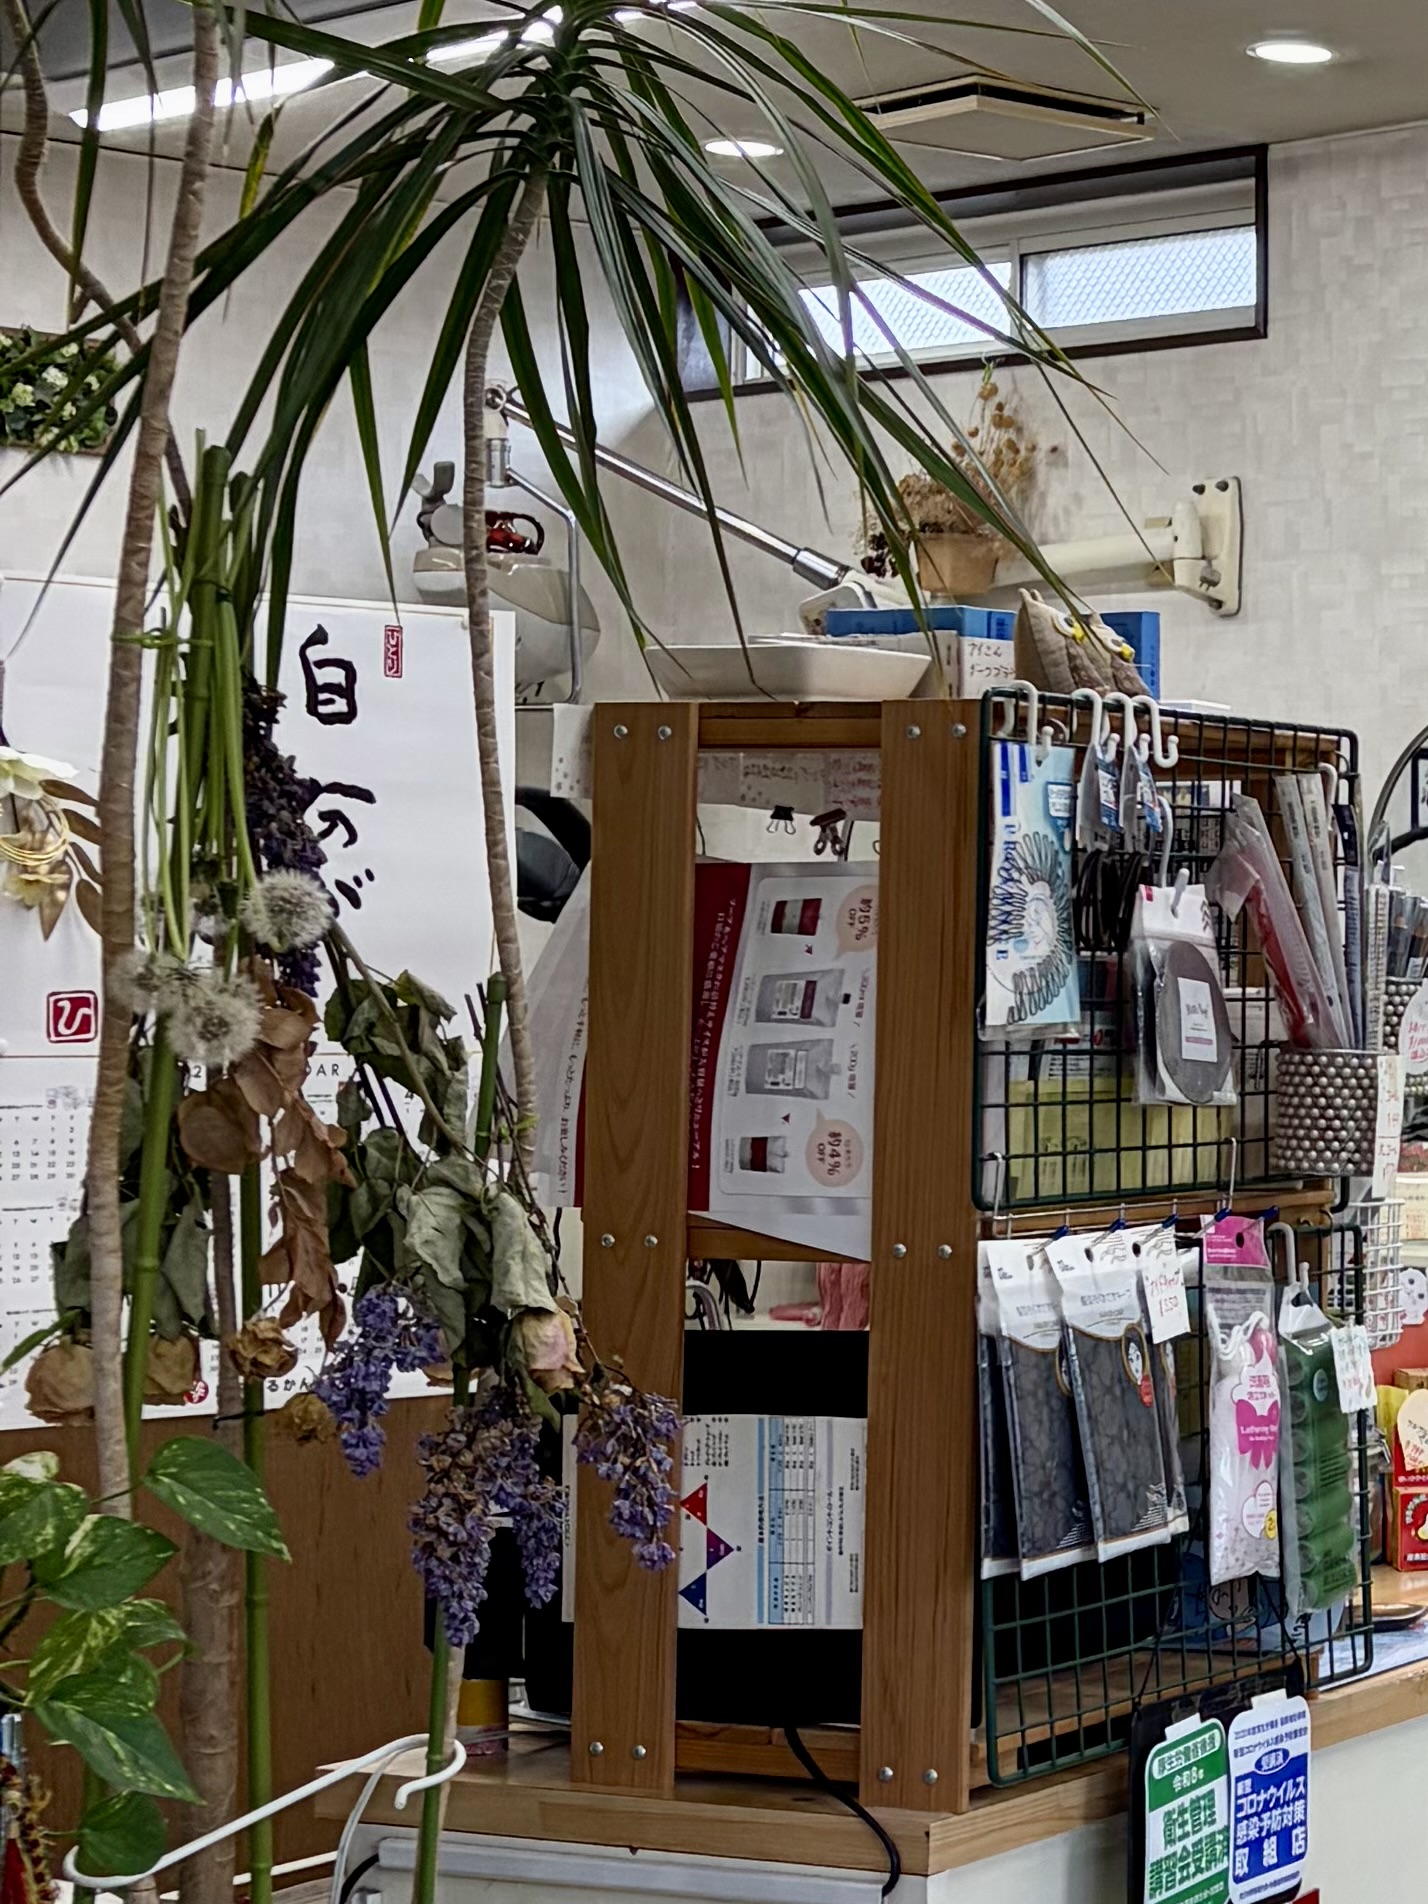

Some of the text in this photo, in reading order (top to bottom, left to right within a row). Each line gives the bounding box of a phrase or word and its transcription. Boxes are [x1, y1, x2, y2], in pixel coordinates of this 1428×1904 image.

[1162, 1788, 1217, 1850] 衛生管理
[1236, 1775, 1307, 1818] コロナウイルス
[1235, 1799, 1306, 1846] 感染予防対策
